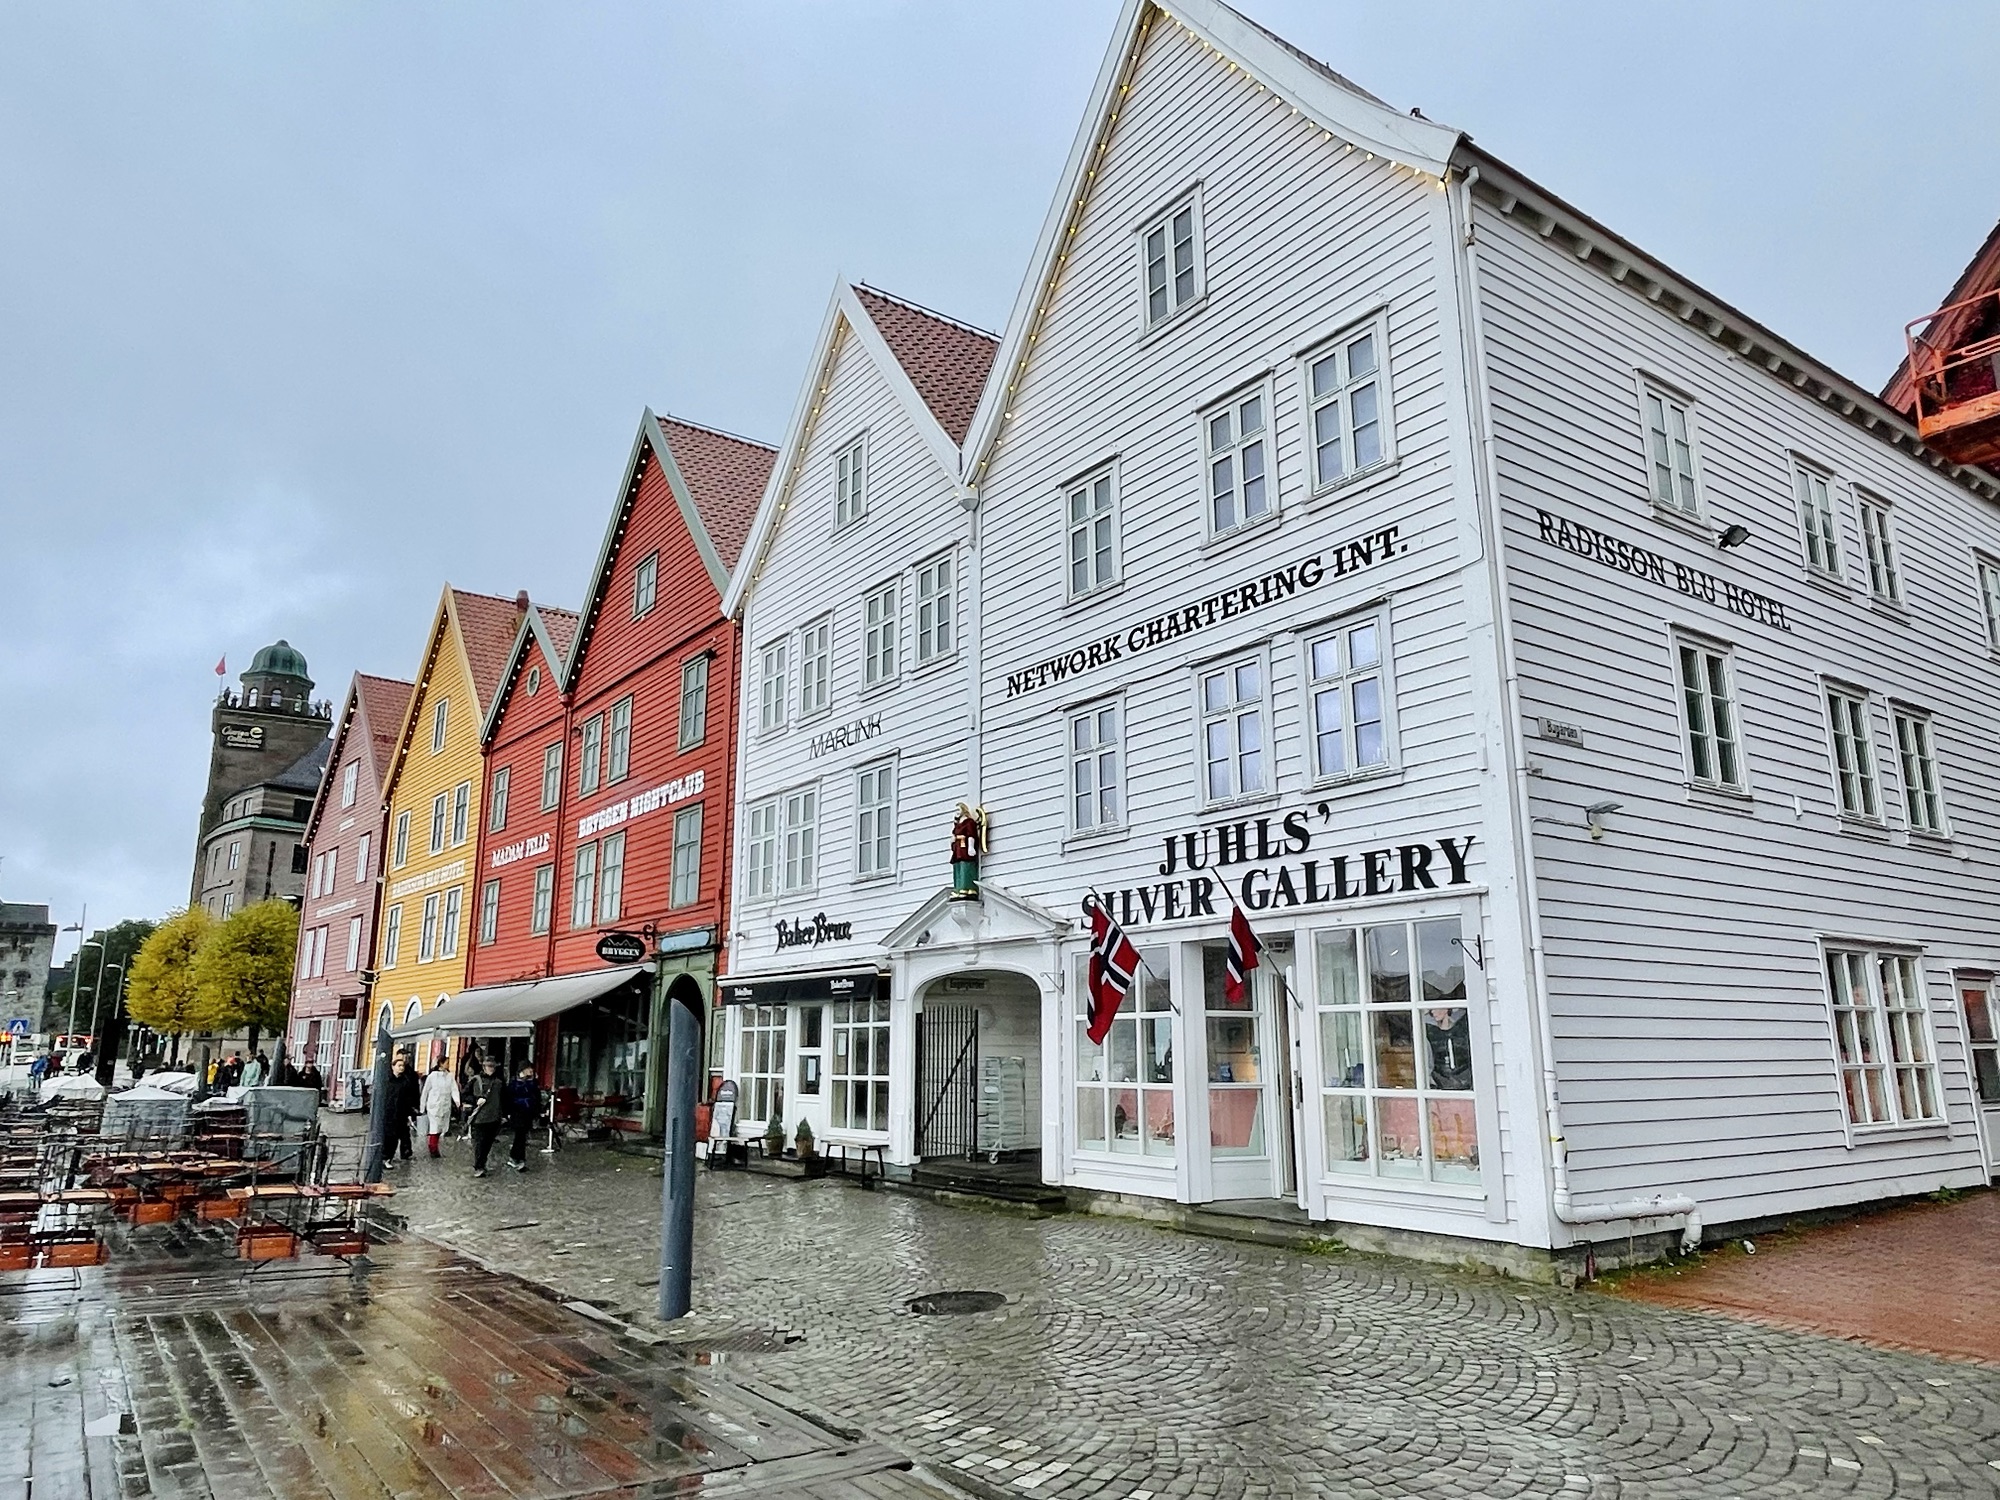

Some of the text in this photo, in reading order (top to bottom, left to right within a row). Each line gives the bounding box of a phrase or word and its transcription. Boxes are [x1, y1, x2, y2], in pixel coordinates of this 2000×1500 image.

[1537, 509, 1792, 632] RADISSON BLU HOTEL
[1007, 525, 1409, 698] NETWORK CHARTERING INT.
[809, 711, 882, 761] MARLINK
[578, 769, 705, 839] BRYGGEN NIGHTCLUB
[491, 841, 525, 869] MADAM
[1081, 835, 1476, 930] SILVER GALLERY
[601, 946, 640, 957] BRYGGEN
